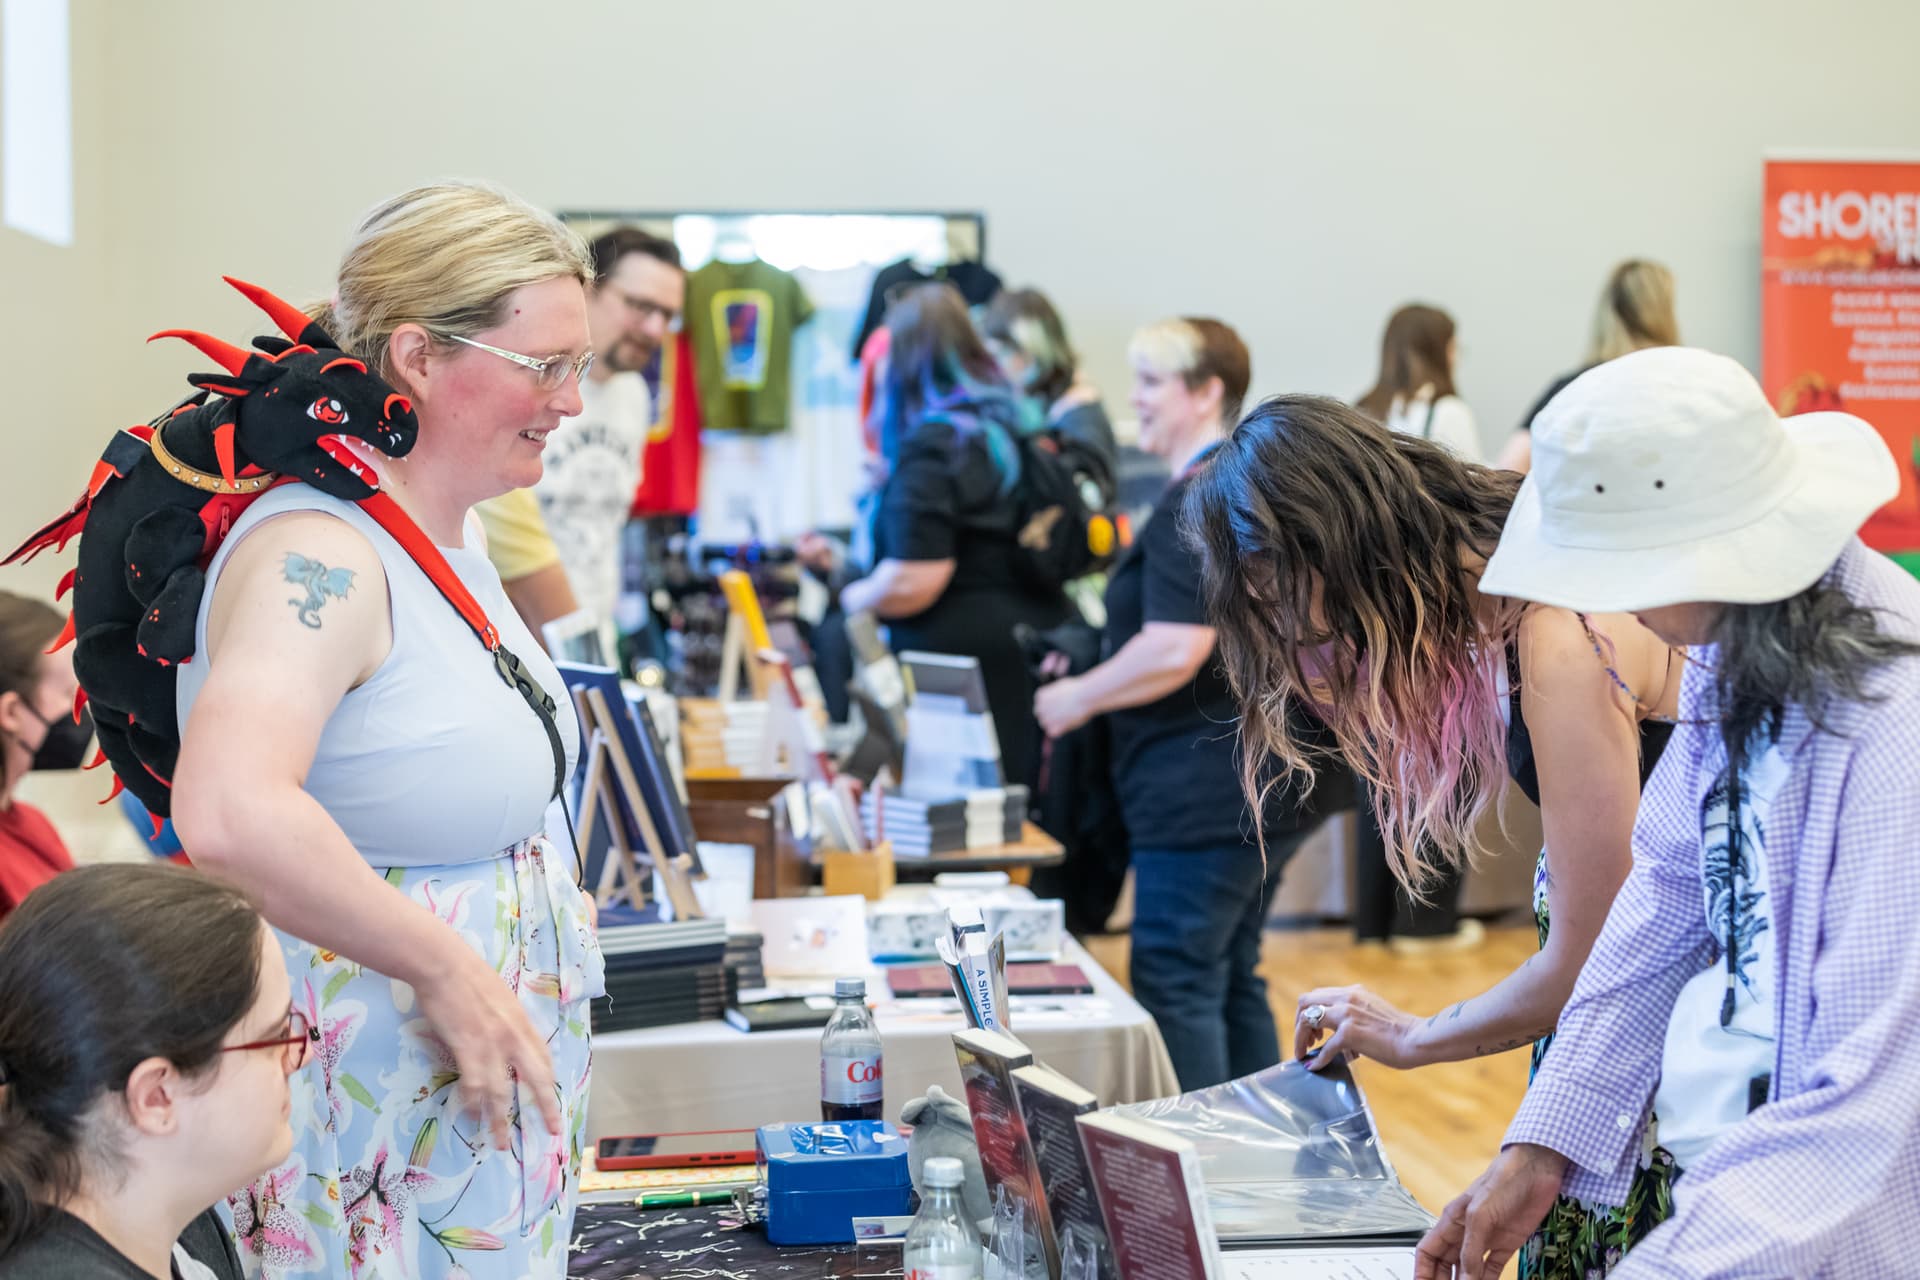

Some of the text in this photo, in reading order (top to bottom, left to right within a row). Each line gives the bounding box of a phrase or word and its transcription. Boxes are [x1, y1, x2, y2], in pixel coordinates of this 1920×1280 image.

[1778, 191, 1920, 240] SHORE
[976, 969, 993, 1025] A SIMPLE
